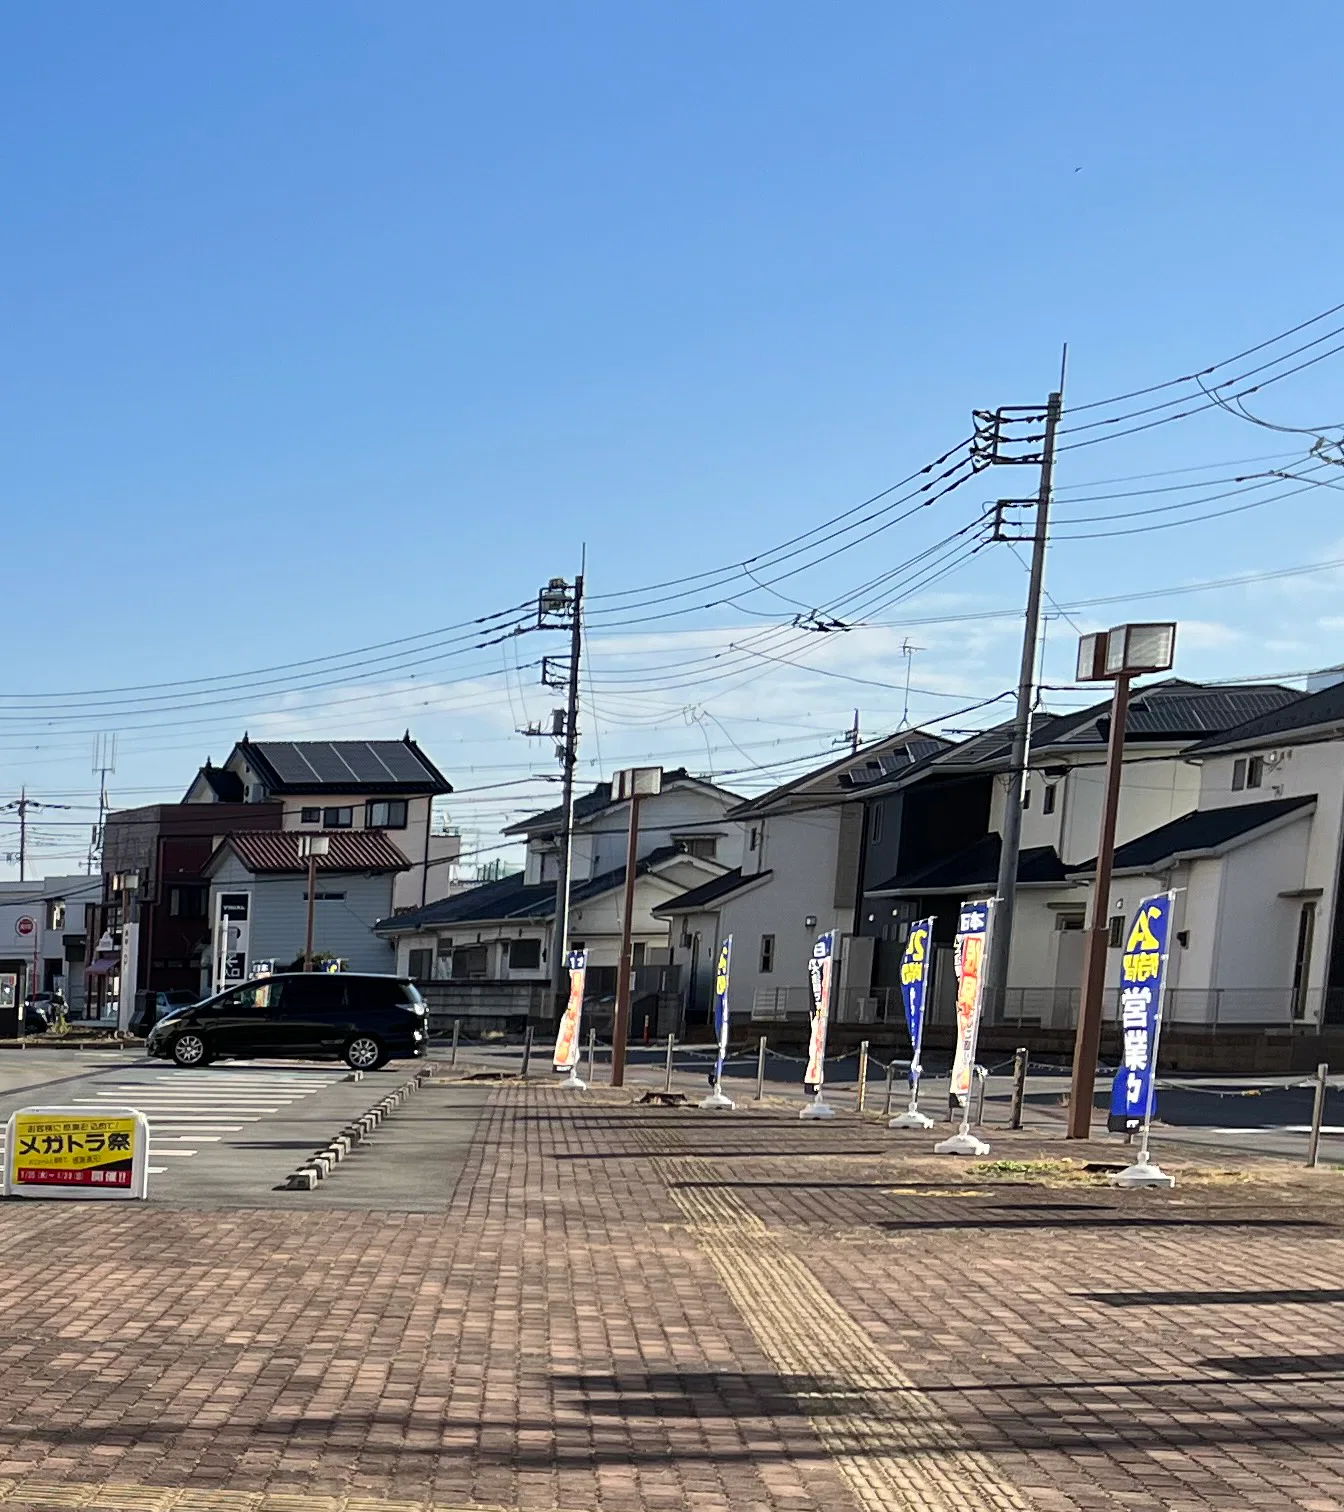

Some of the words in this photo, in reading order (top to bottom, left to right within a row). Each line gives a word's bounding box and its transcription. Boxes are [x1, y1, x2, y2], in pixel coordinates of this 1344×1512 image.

[19, 1133, 130, 1155] メガトラ祭
